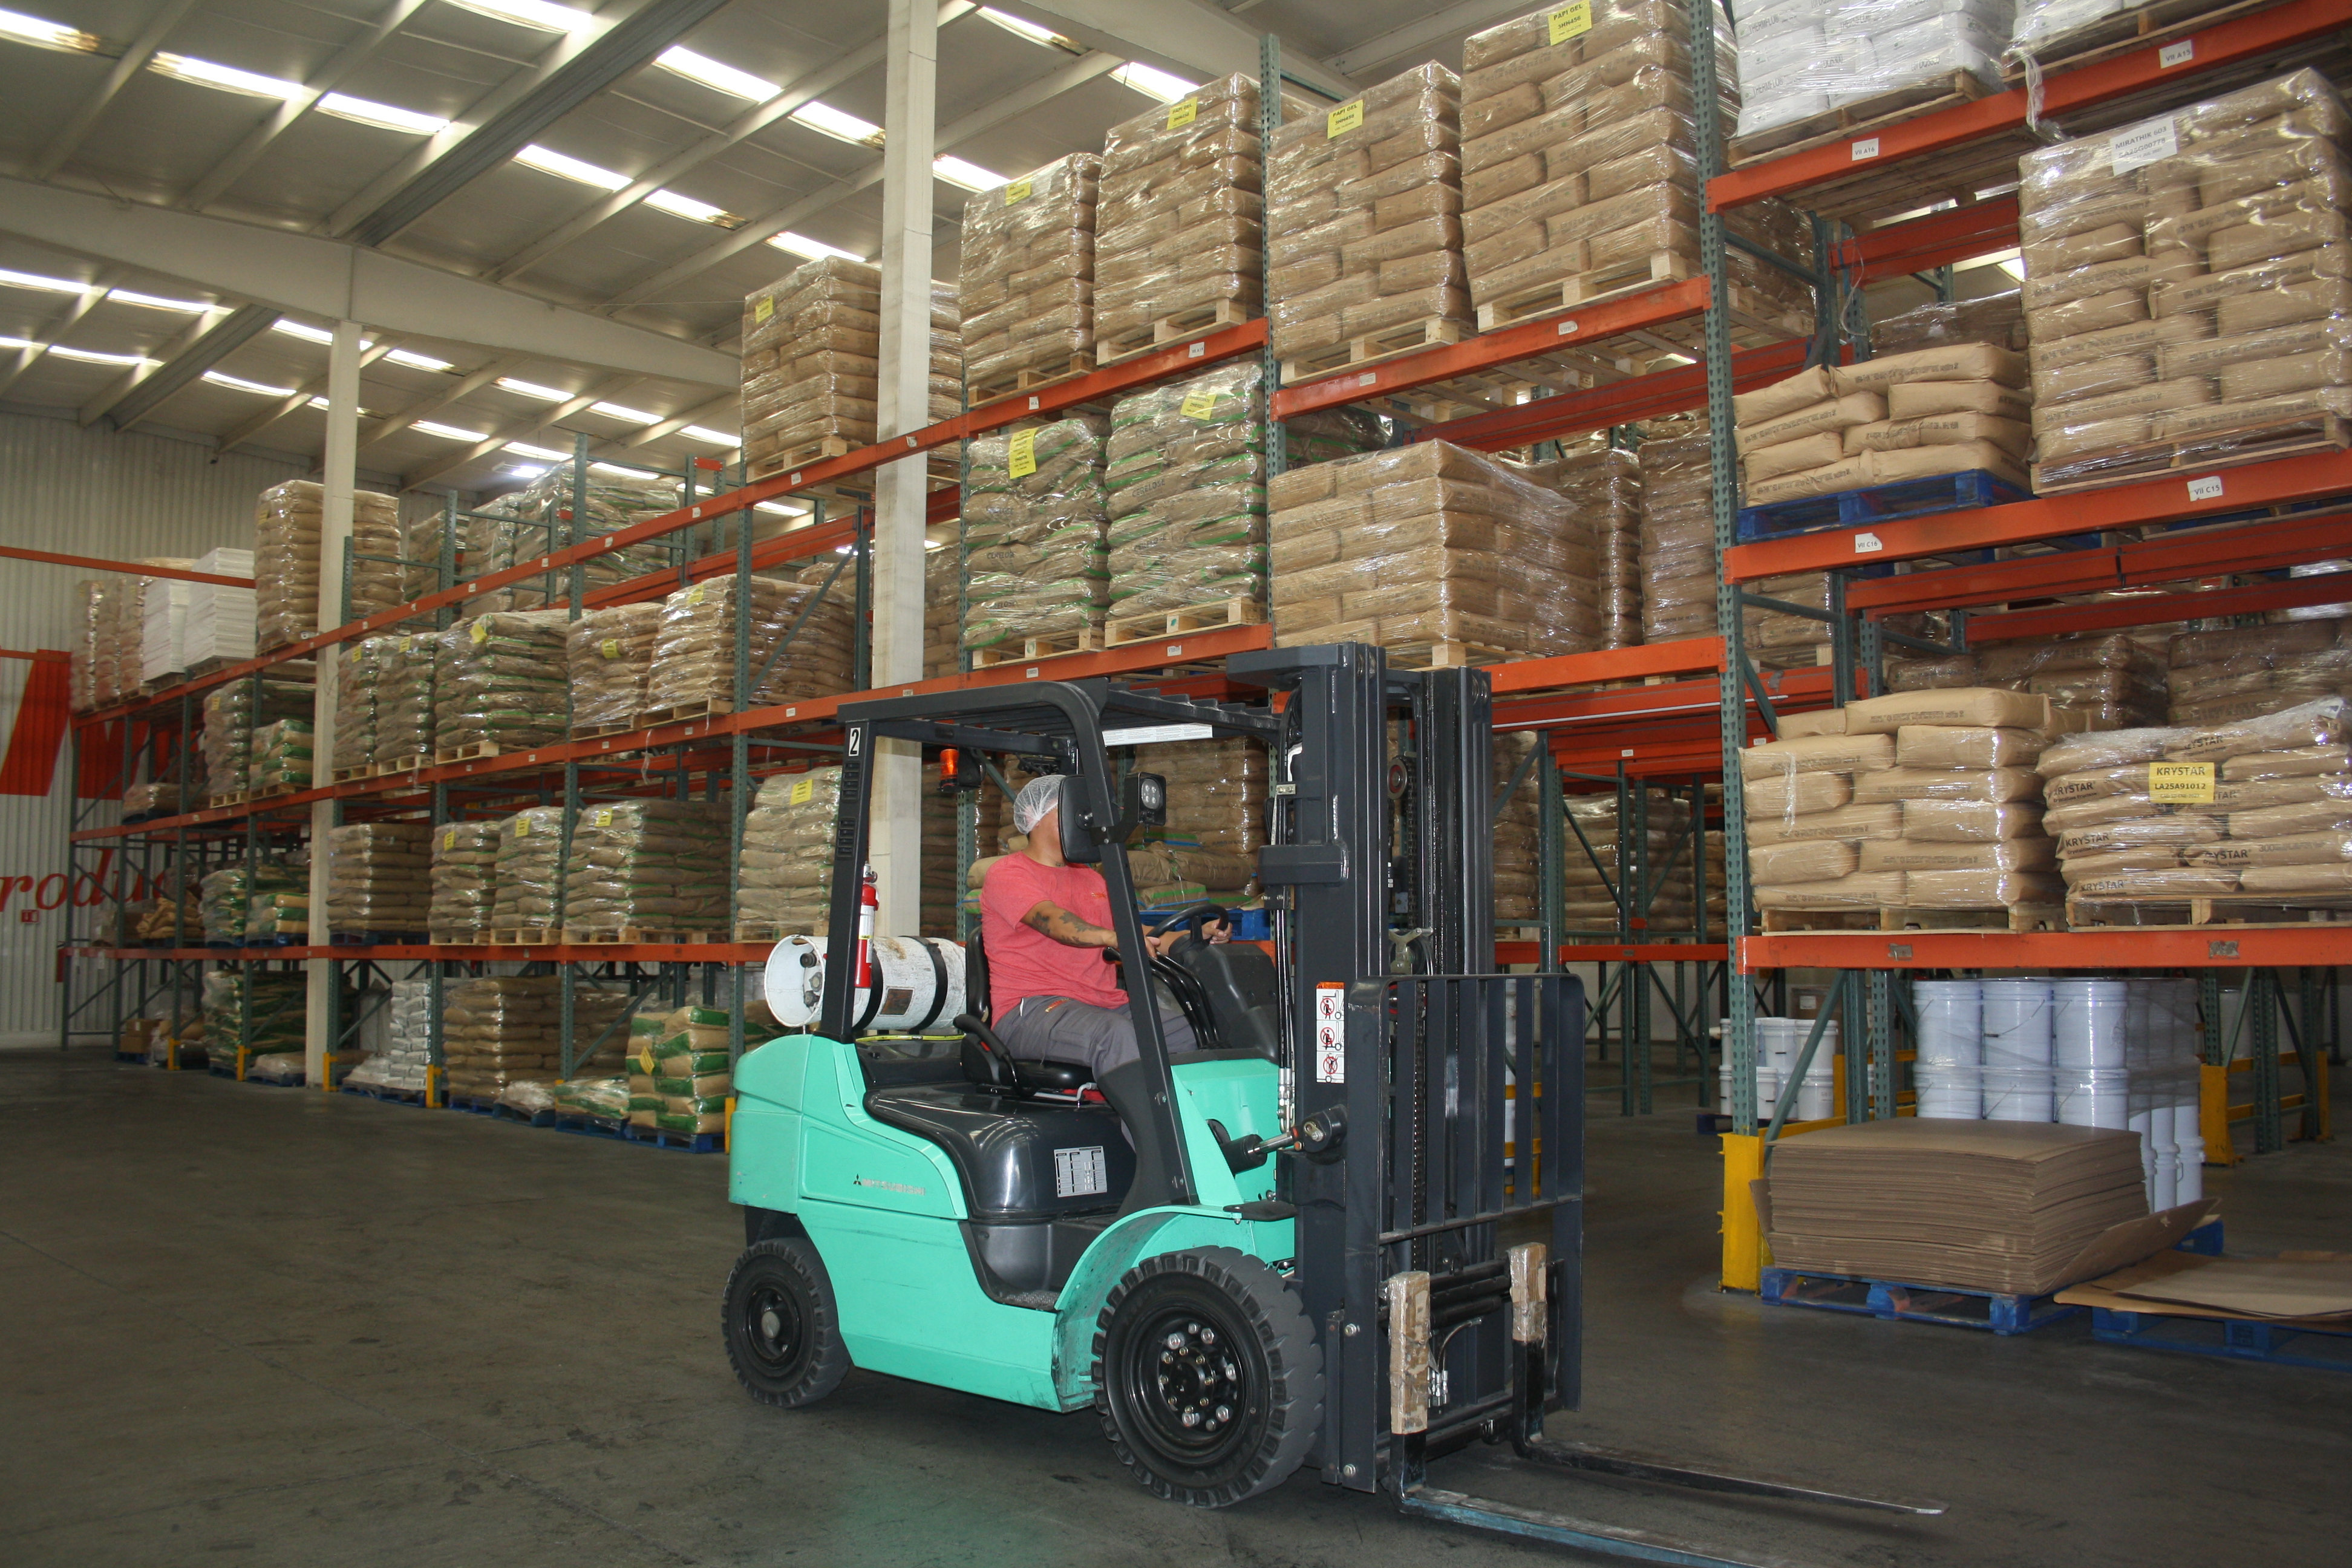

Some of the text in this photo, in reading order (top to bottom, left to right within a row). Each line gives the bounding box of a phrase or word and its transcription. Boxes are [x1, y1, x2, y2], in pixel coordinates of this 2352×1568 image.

[1553, 4, 1584, 21] PAPI GEL
[1332, 108, 1346, 118] PAPI
[2115, 126, 2167, 149] MIRATHIK 603
[1864, 146, 1875, 154] A16
[1132, 478, 1166, 497] CERELOSE
[2206, 484, 2220, 493] C15
[850, 729, 860, 755] 2
[2156, 766, 2206, 776] KRYSTAR
